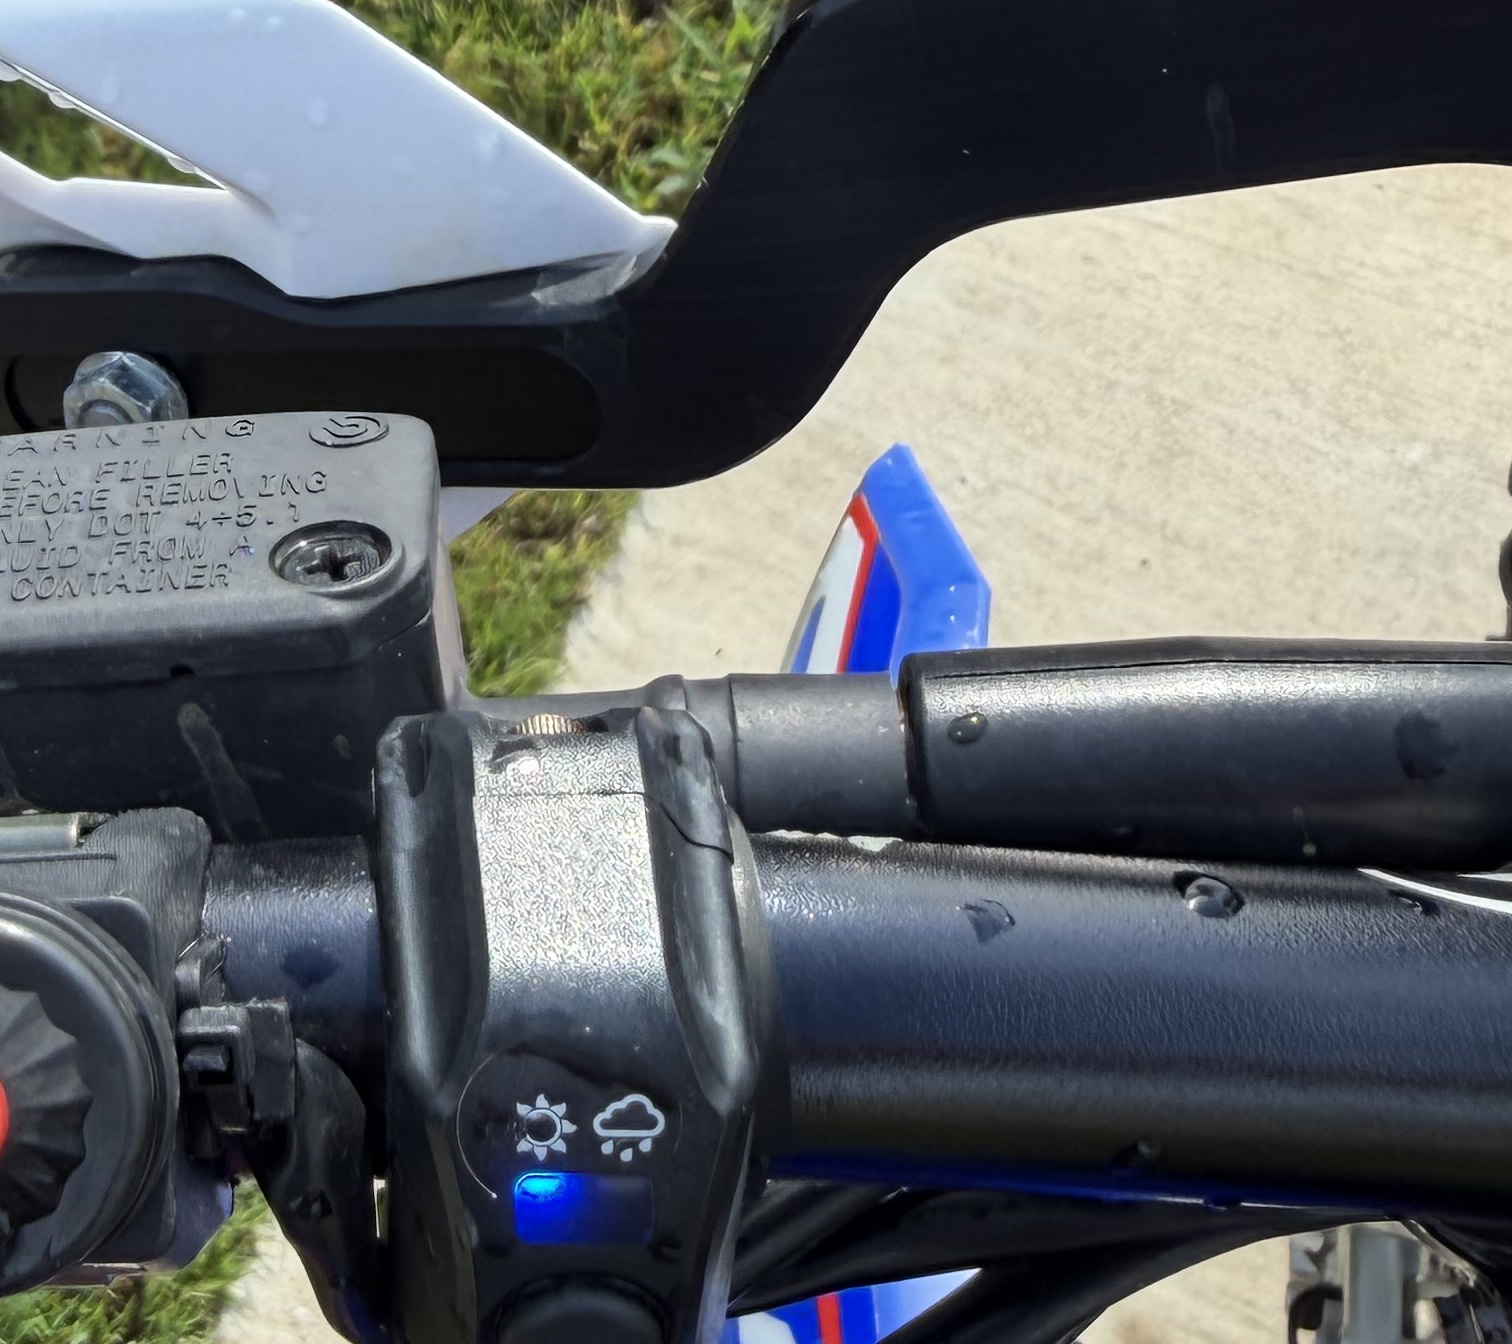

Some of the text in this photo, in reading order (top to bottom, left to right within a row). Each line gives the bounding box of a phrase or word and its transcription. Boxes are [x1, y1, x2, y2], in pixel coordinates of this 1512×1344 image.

[94, 452, 234, 484] FILLER
[135, 471, 328, 506] REMOVING
[87, 510, 162, 538] DOT
[107, 536, 205, 565] FROM
[228, 535, 256, 557] A
[10, 563, 231, 602] CONTAINER
